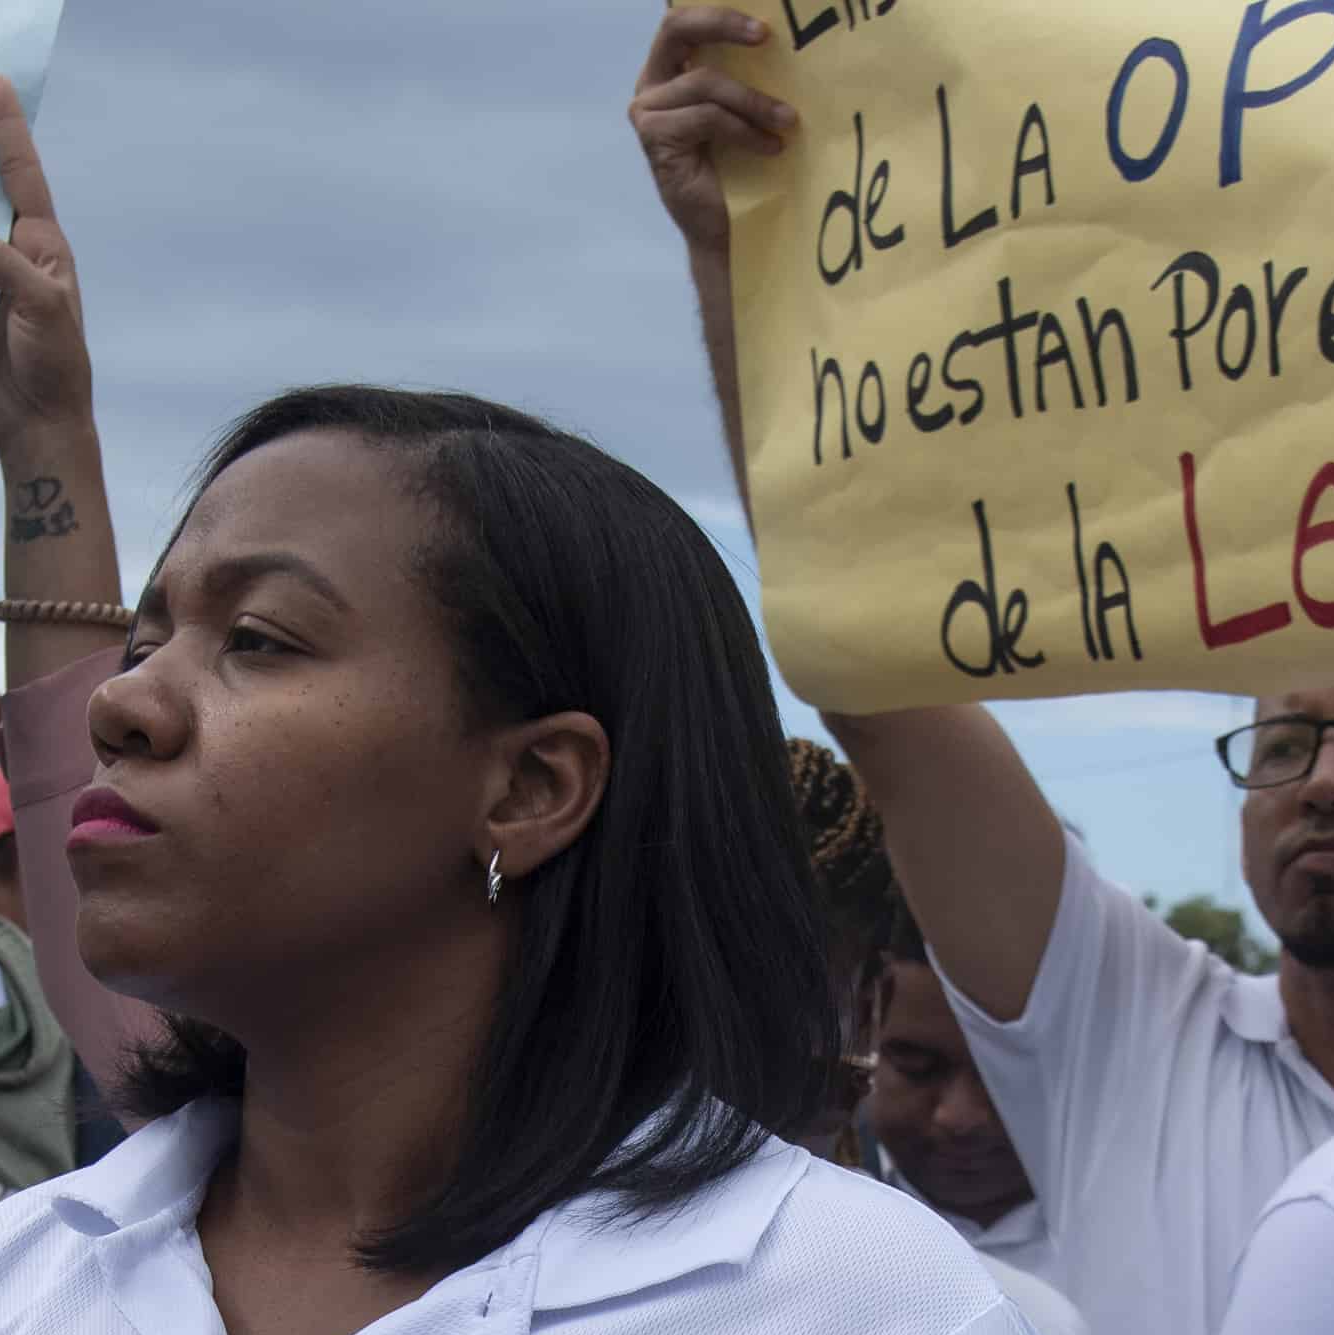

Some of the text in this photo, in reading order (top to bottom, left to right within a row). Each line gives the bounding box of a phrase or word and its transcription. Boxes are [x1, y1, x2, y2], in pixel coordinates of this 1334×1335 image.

[816, 111, 905, 287] de
[936, 83, 1055, 248] LA
[810, 346, 887, 466] no
[940, 499, 1046, 678] de
